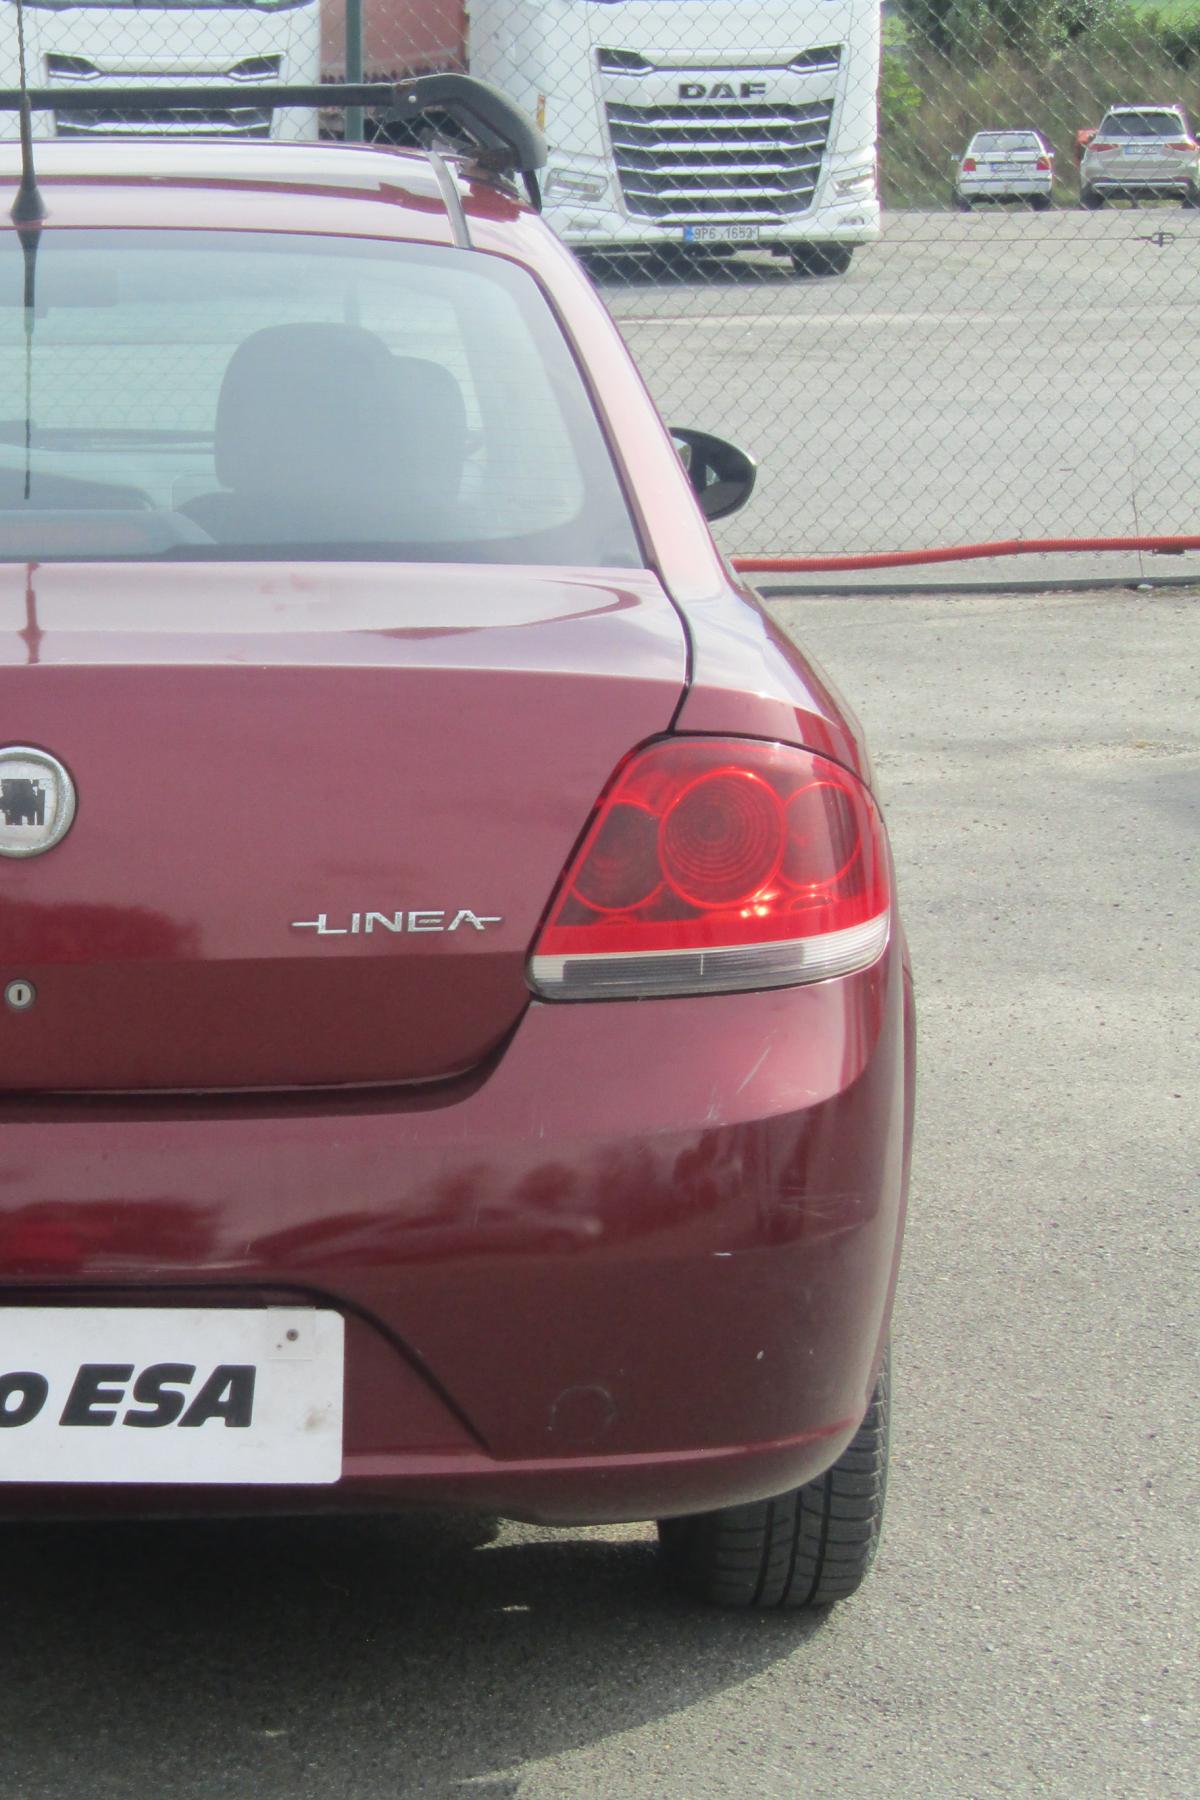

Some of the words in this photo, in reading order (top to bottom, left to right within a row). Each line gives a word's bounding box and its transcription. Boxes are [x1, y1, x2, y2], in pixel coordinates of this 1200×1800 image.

[679, 82, 766, 99] DAF
[291, 910, 502, 935] LINEA
[58, 1363, 257, 1428] ESA
